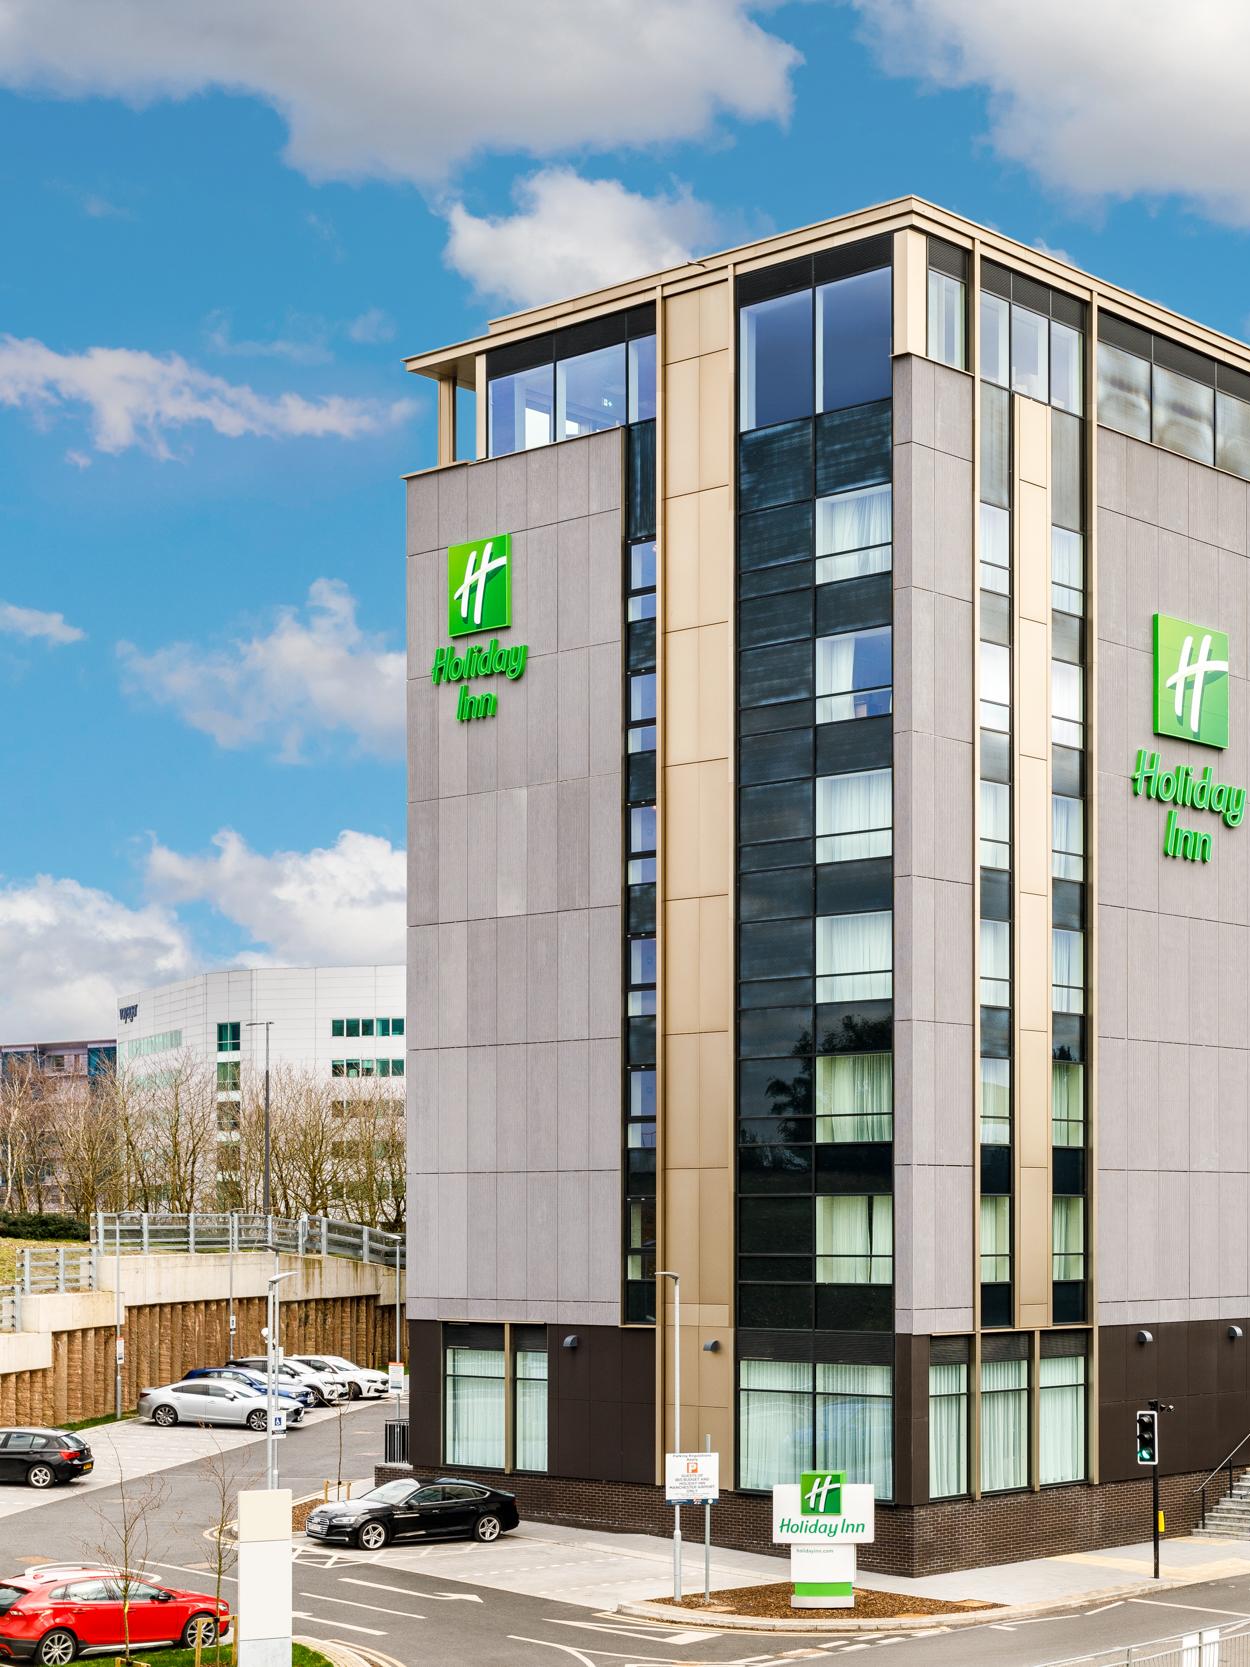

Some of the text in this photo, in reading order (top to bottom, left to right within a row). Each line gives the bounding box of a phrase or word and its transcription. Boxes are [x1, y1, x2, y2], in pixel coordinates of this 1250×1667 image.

[432, 639, 528, 685] Holiday
[456, 685, 497, 721] Inn
[1131, 748, 1247, 828] Holiday
[1164, 809, 1213, 863] Inn
[779, 1518, 865, 1537] Holiday Inn
